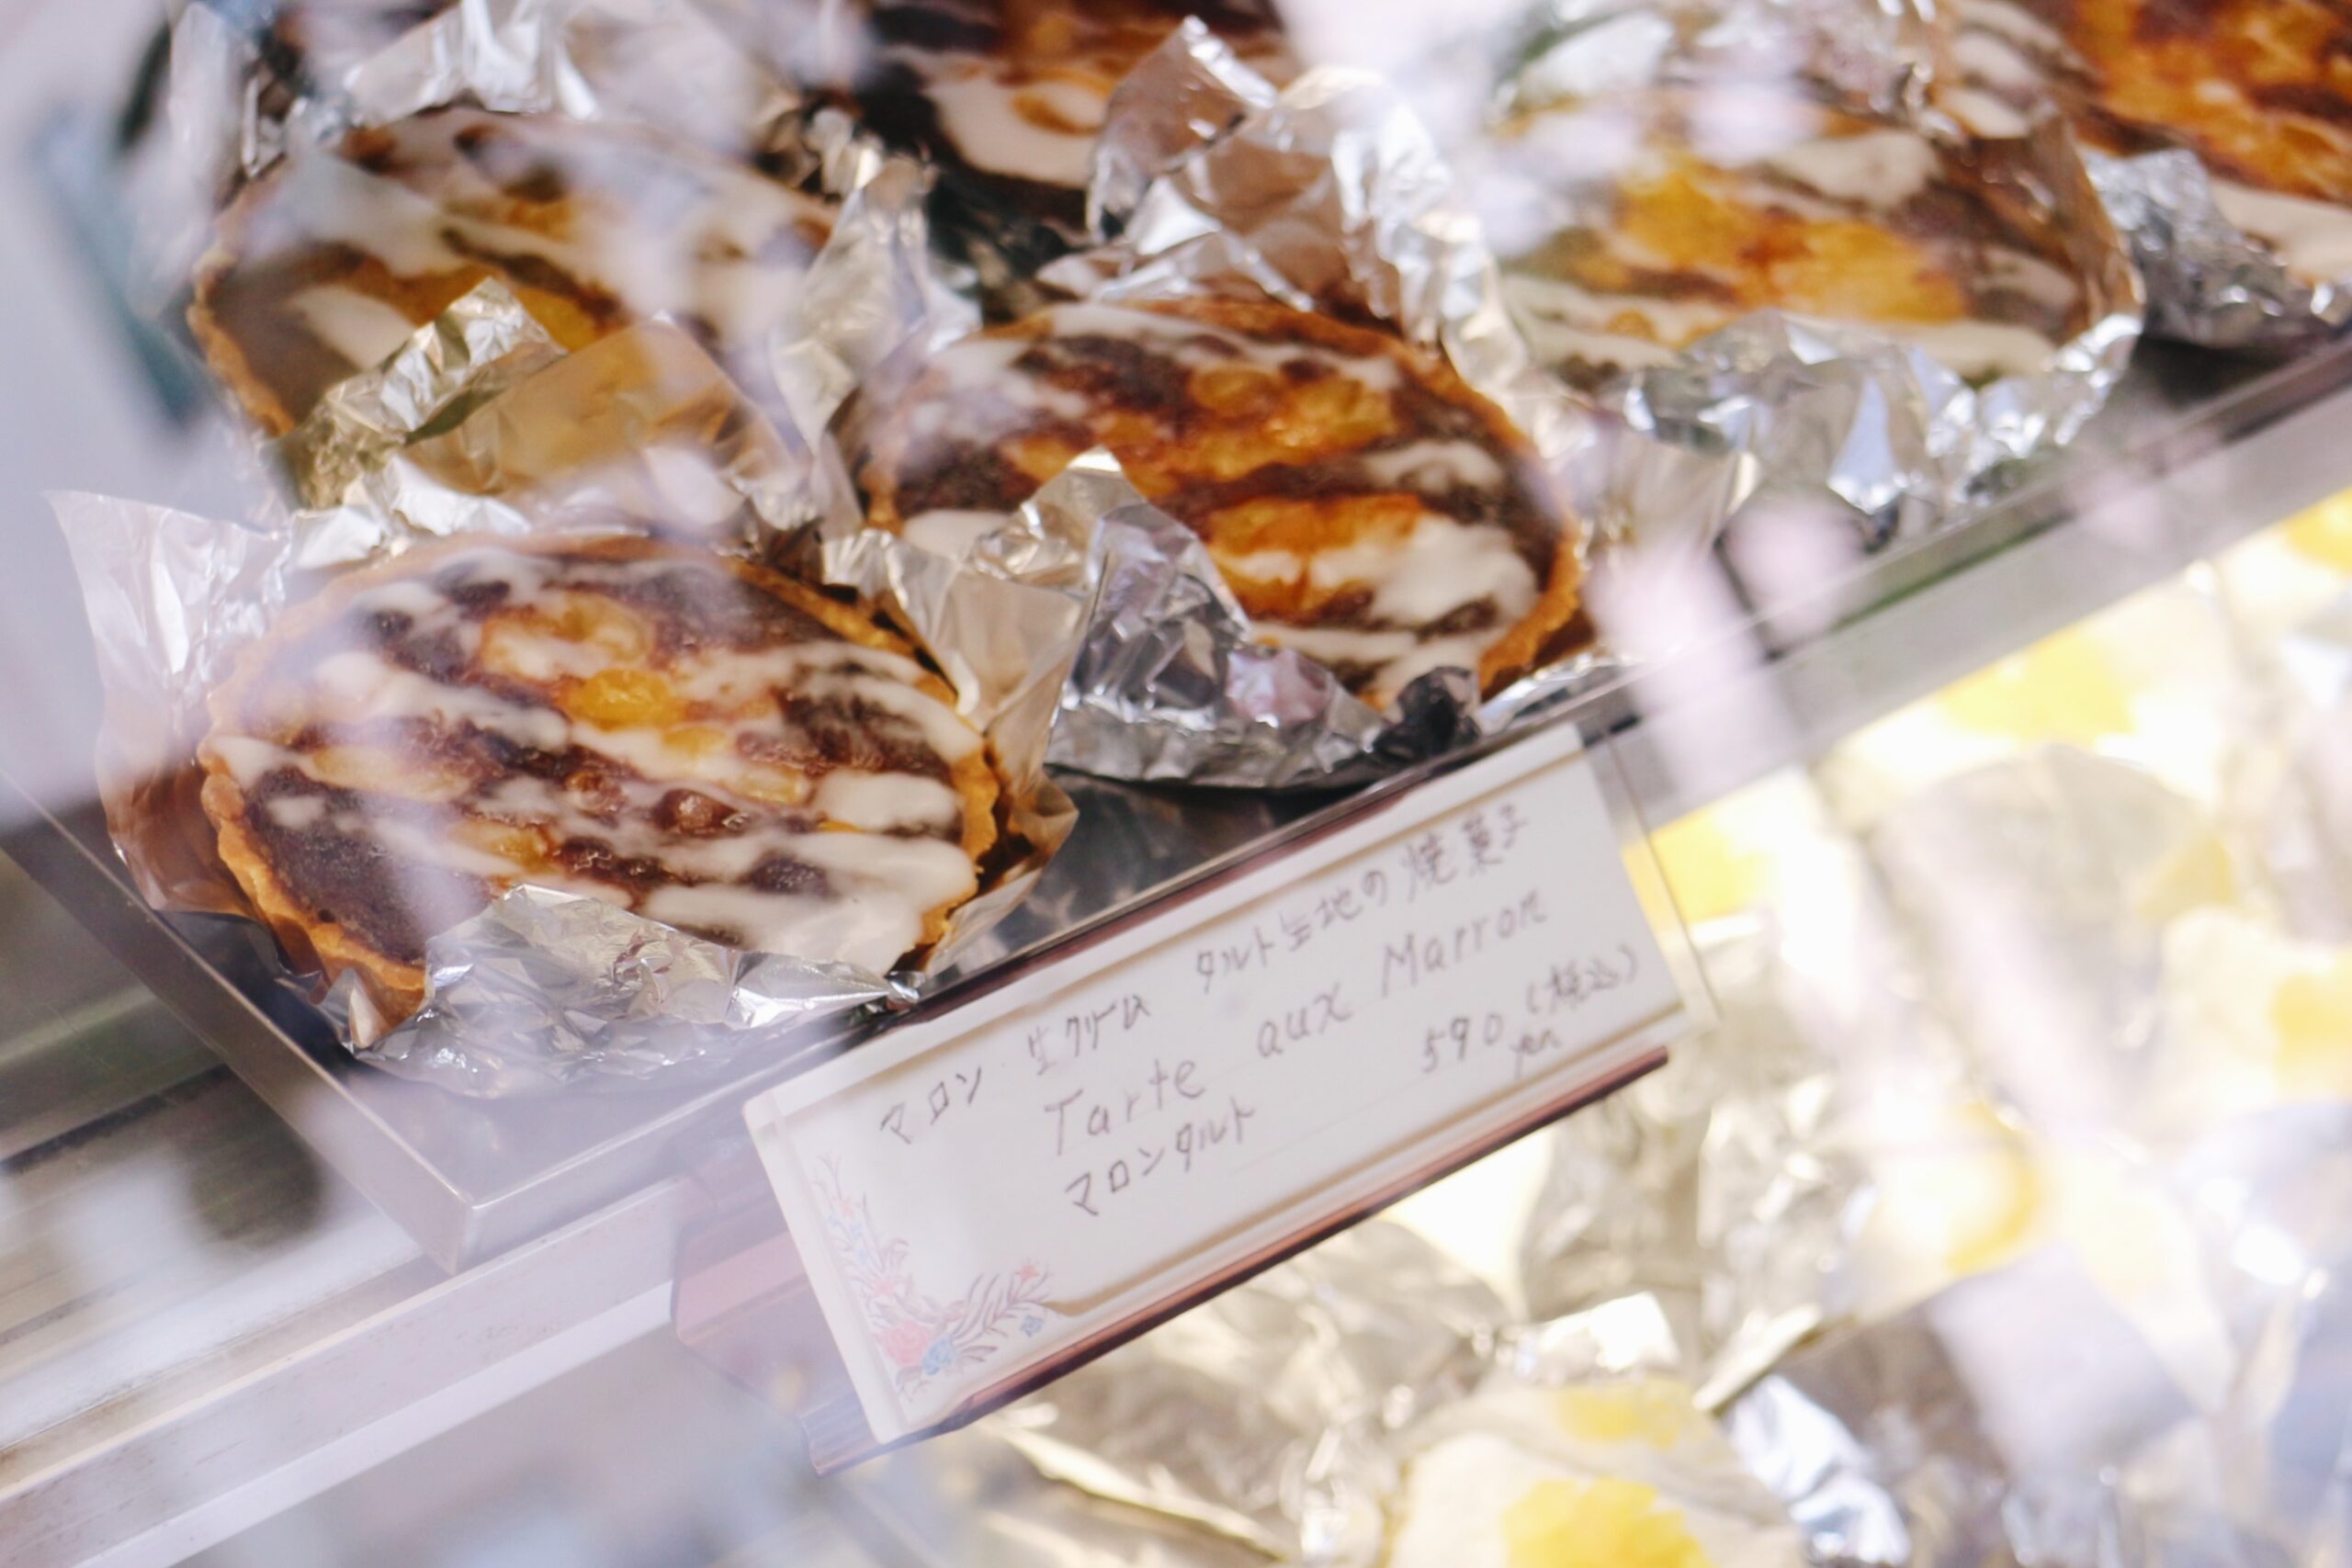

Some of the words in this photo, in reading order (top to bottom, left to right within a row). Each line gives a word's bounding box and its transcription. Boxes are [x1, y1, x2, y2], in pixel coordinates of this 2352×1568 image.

[1045, 1058, 1206, 1156] Tarte
[1258, 982, 1353, 1058] aux
[1381, 889, 1548, 998] Marron
[1422, 1013, 1505, 1074] 590
[879, 1066, 982, 1145] マロン
[1065, 1096, 1256, 1217] マロンタルト
